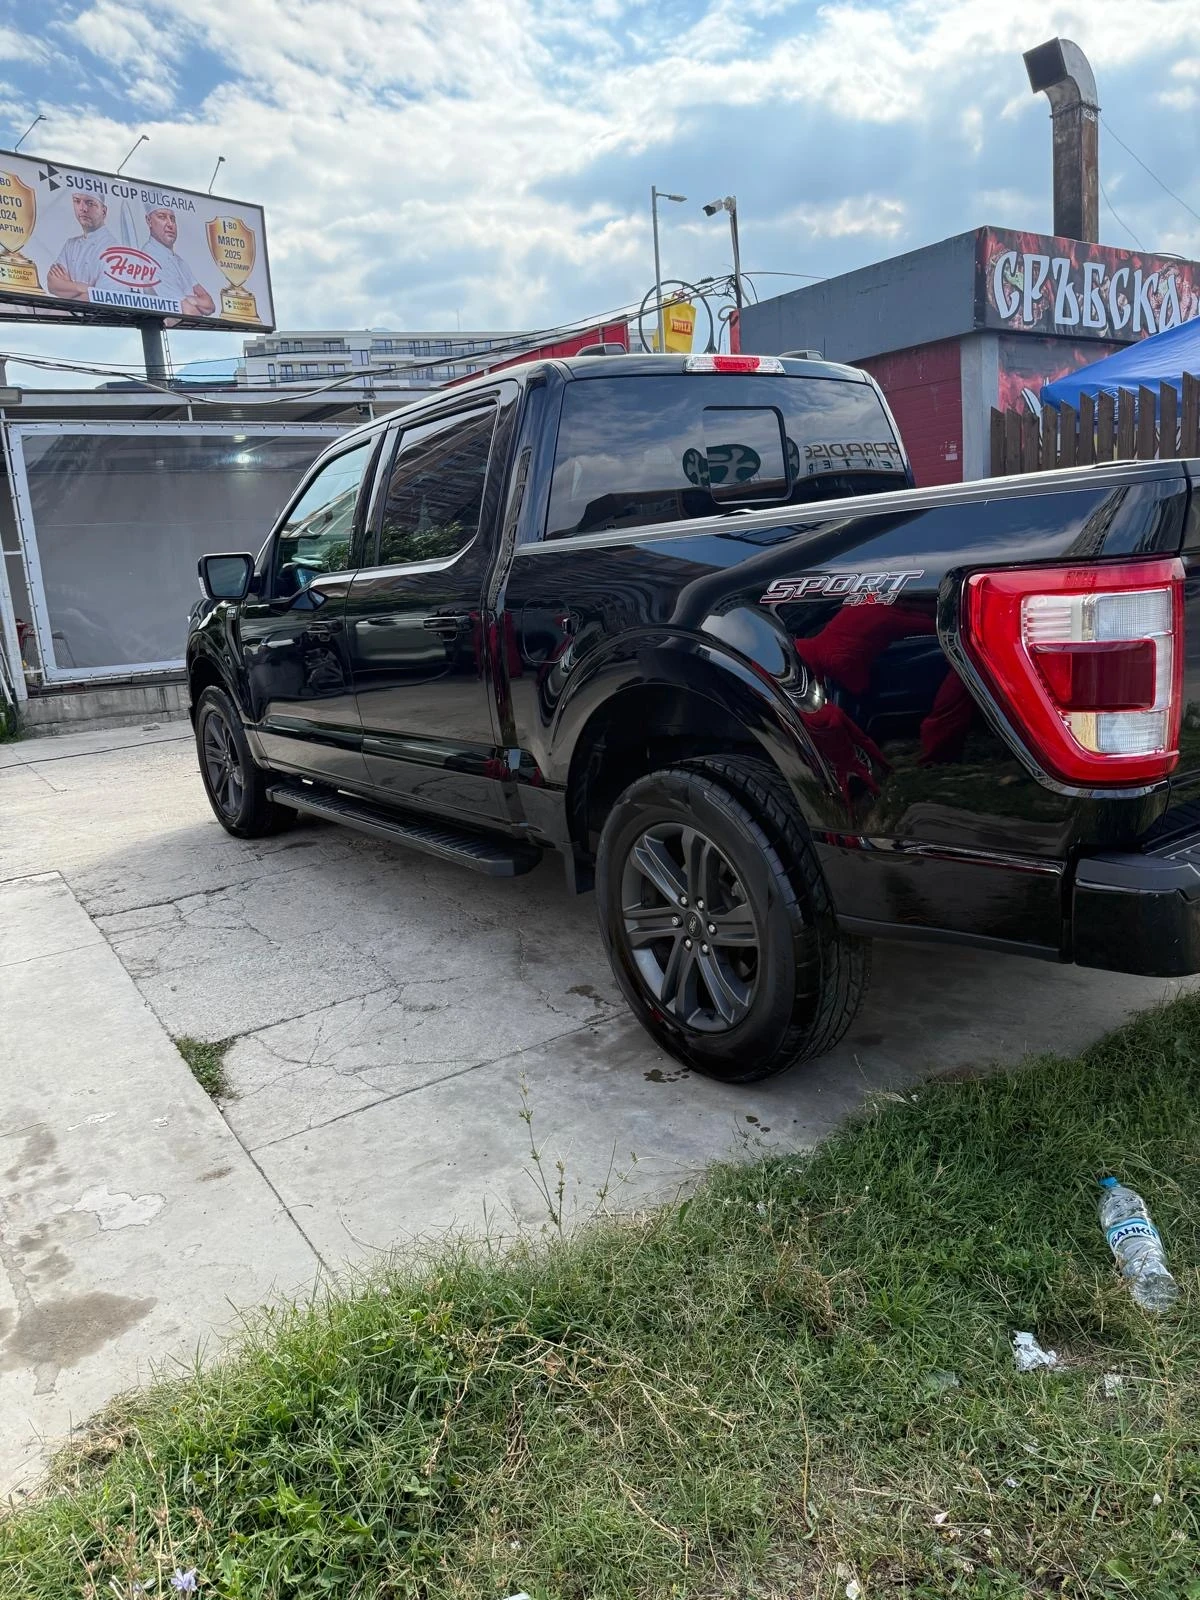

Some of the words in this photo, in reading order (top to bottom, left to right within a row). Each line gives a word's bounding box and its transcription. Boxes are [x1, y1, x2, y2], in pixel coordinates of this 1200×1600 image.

[0, 195, 22, 208] СТО
[65, 175, 108, 194] SUSHI
[111, 184, 138, 200] CUP
[141, 190, 196, 212] BULGARIA
[0, 209, 17, 221] 024
[217, 235, 245, 249] МЯСТО
[224, 249, 242, 260] 2025
[105, 255, 157, 281] Happy
[91, 289, 180, 313] ШАМПИОНИТЕ
[993, 251, 1182, 334] СРЪБСКА
[759, 569, 925, 604] SPORT
